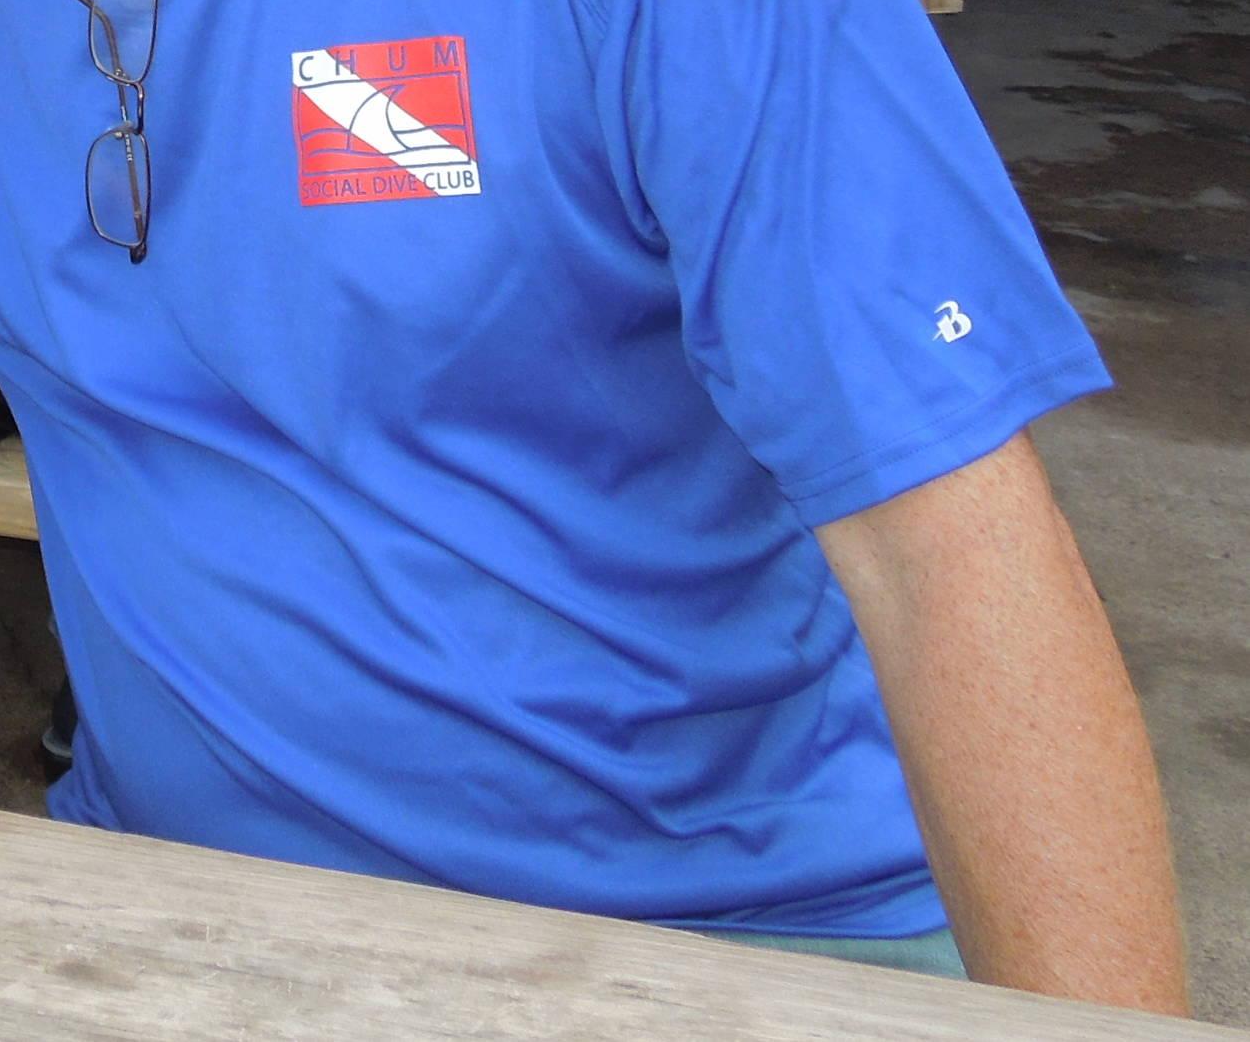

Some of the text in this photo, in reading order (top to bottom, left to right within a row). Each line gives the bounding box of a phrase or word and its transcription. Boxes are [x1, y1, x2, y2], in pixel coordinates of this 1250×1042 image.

[299, 41, 460, 81] CHUM
[301, 170, 475, 200] SOCIAL DIVE CLUB
